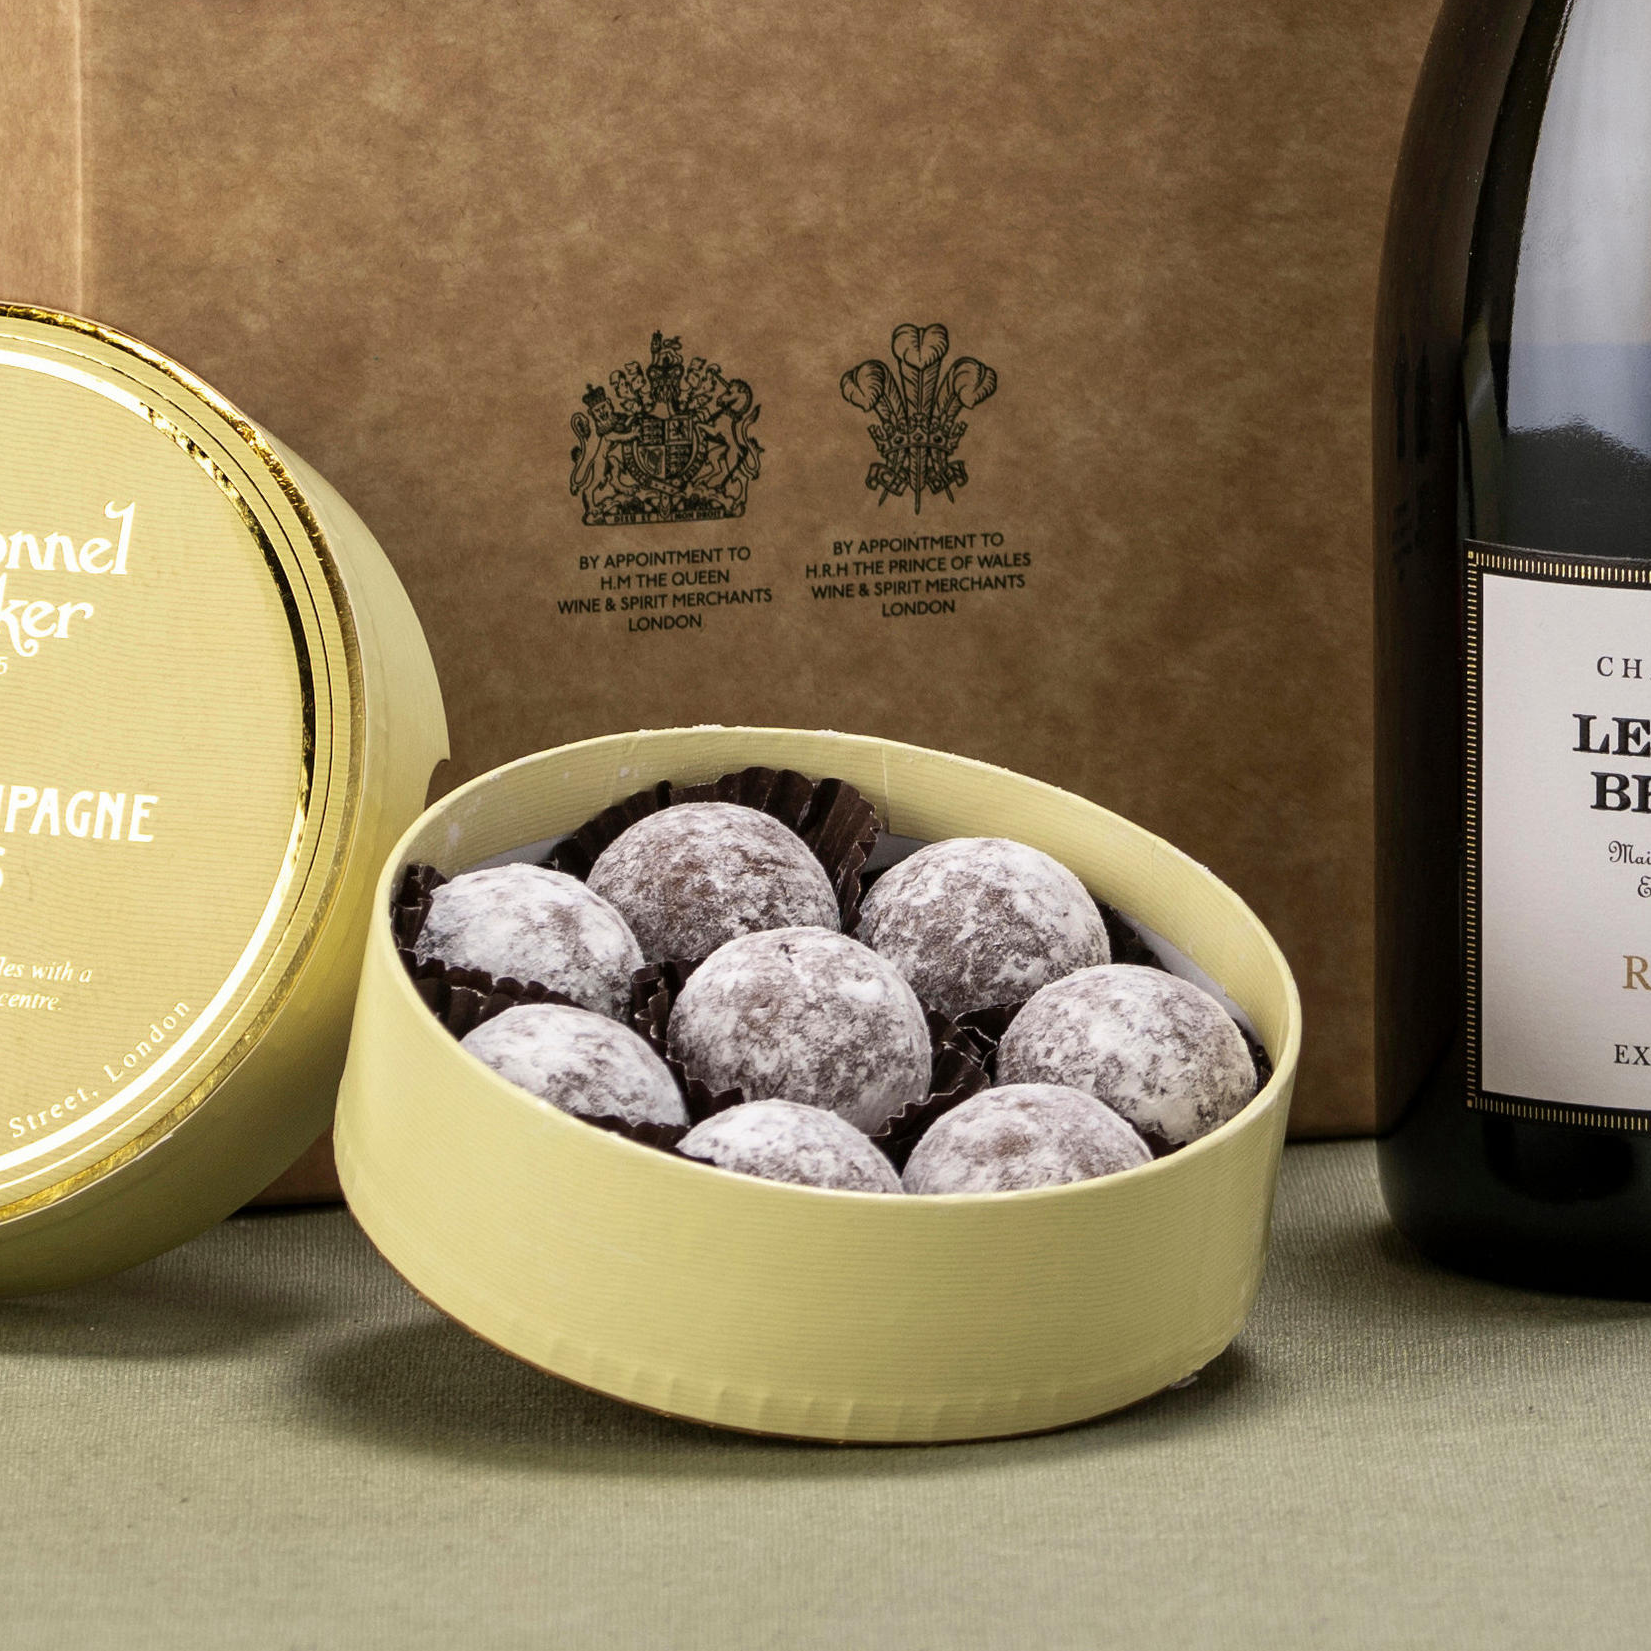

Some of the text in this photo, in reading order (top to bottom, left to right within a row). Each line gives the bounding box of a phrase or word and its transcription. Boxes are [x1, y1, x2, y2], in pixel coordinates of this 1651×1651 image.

[833, 531, 1005, 556] BY APPOINTMENT TO
[579, 545, 751, 571] BY APPOINTMENT TO
[805, 551, 1032, 579] H.R.H THE PRINCE OF WALES
[600, 569, 730, 591] H.M THE QUEEN
[811, 573, 1026, 600] WINE & SPIRIT MERCHANTS
[557, 587, 773, 615] WINE & SPIRIT MERCHANTS
[881, 599, 956, 618] LONDON
[628, 613, 702, 633] LONDON
[32, 961, 74, 981] with
[79, 969, 93, 983] a
[9, 1088, 98, 1138] Street,
[103, 1002, 190, 1083] London
